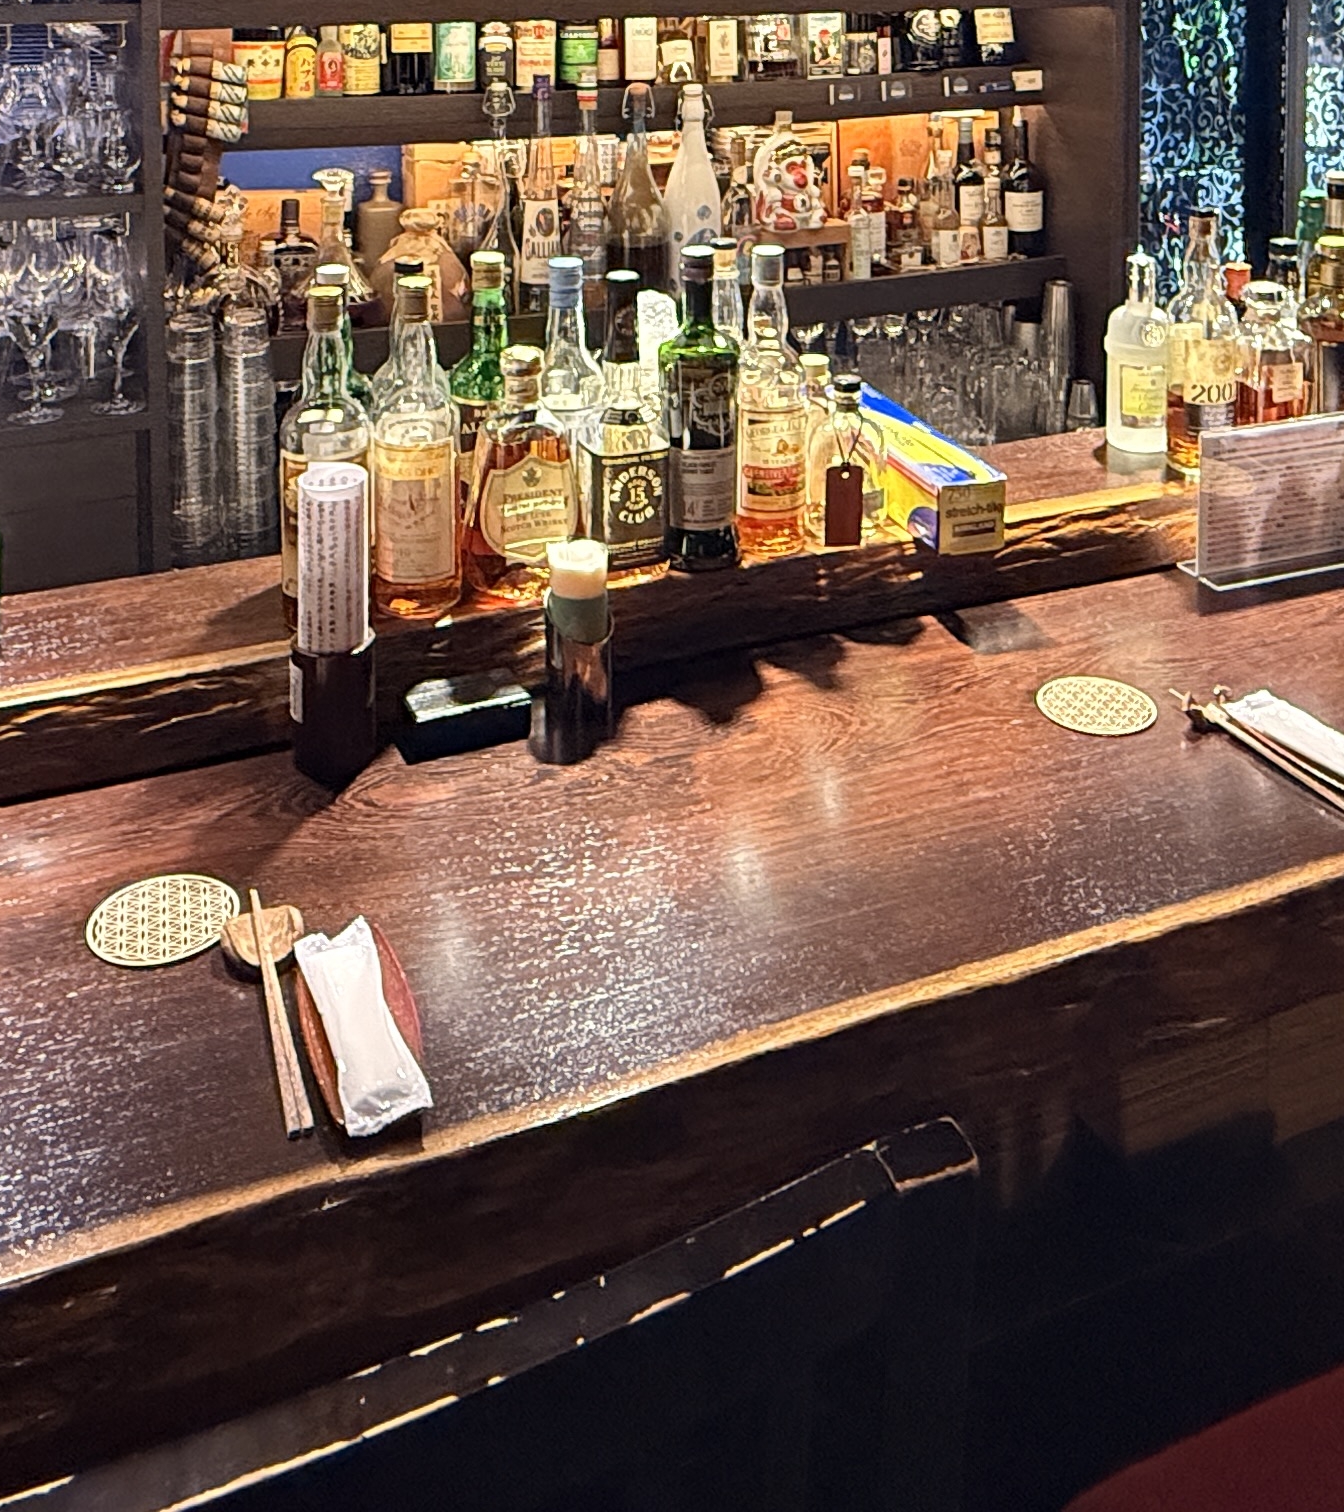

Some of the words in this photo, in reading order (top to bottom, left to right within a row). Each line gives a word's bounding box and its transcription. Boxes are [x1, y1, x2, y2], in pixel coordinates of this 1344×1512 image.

[1190, 383, 1234, 404] 200
[609, 464, 663, 503] ANDERSON
[503, 488, 565, 501] PRESIDENT
[629, 486, 646, 503] 15
[618, 505, 655, 524] CLUB
[501, 520, 534, 533] SCOTCH
[534, 518, 568, 528] WHISKY
